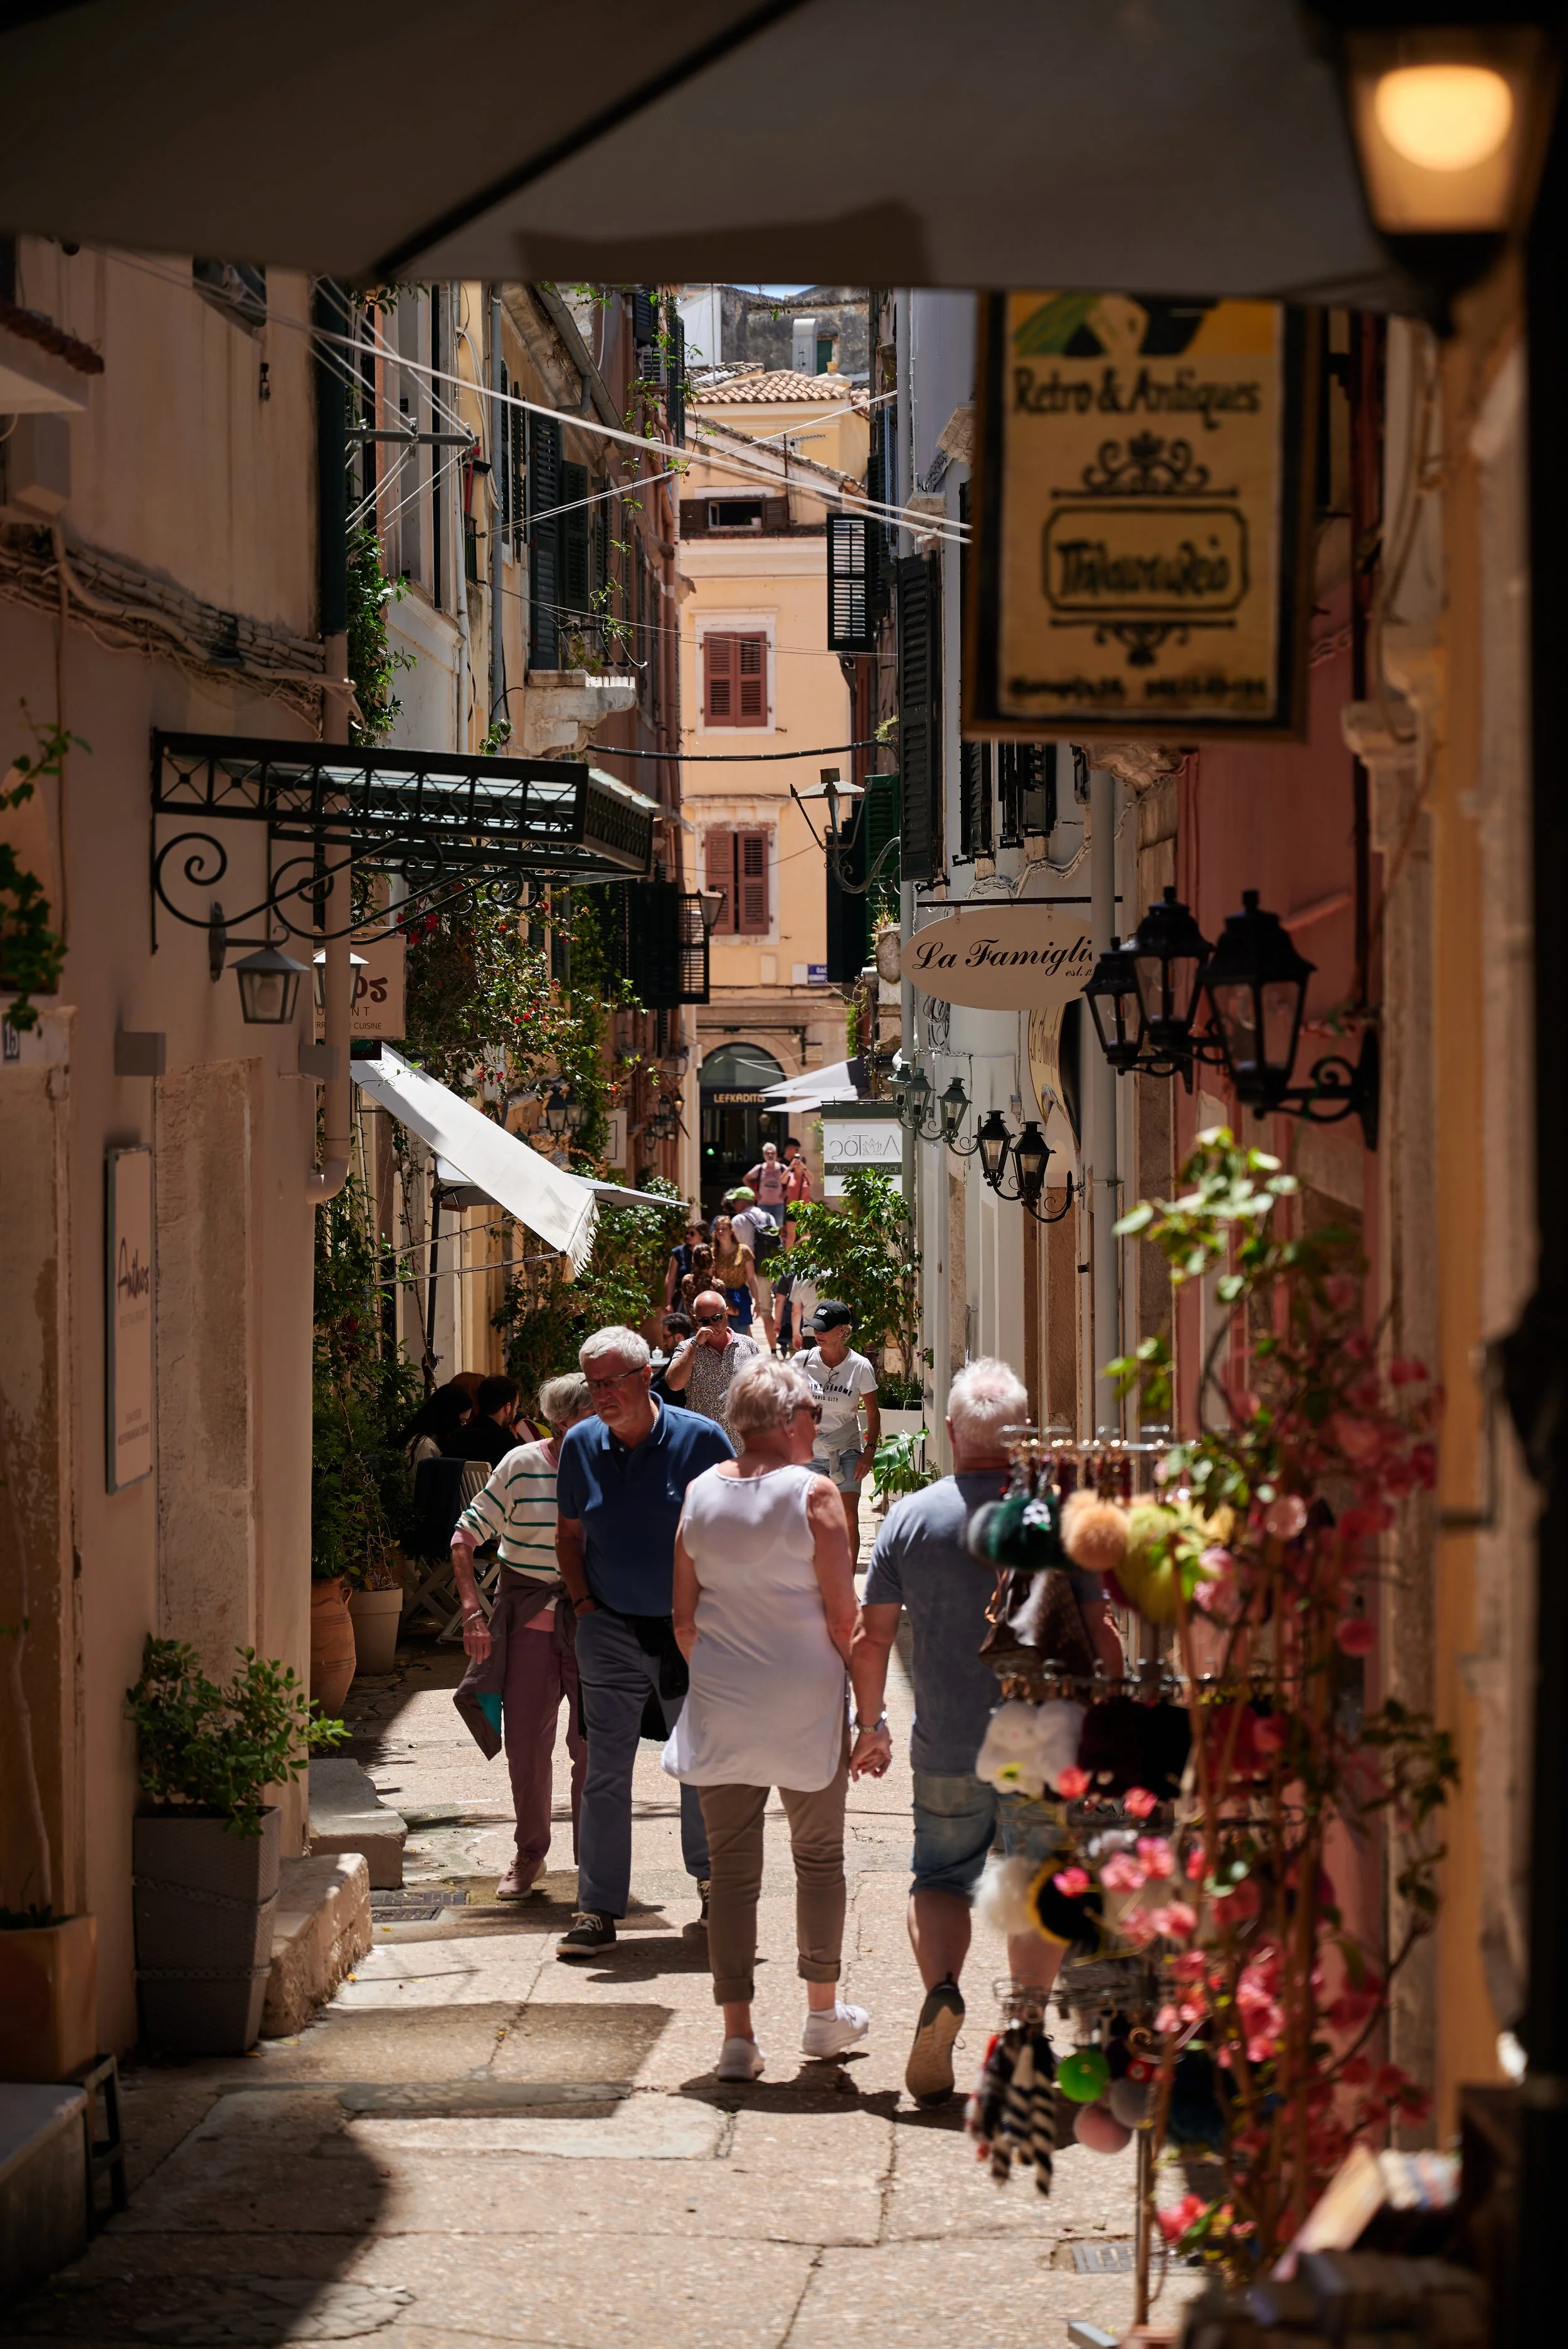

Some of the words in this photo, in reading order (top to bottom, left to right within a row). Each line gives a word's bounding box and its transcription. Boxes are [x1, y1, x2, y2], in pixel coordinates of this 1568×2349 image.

[1012, 366, 1093, 415] Retro
[1098, 366, 1122, 414] &
[912, 941, 956, 970] La
[876, 1165, 898, 1173] SPACE
[826, 1384, 852, 1397] JÉRÔME
